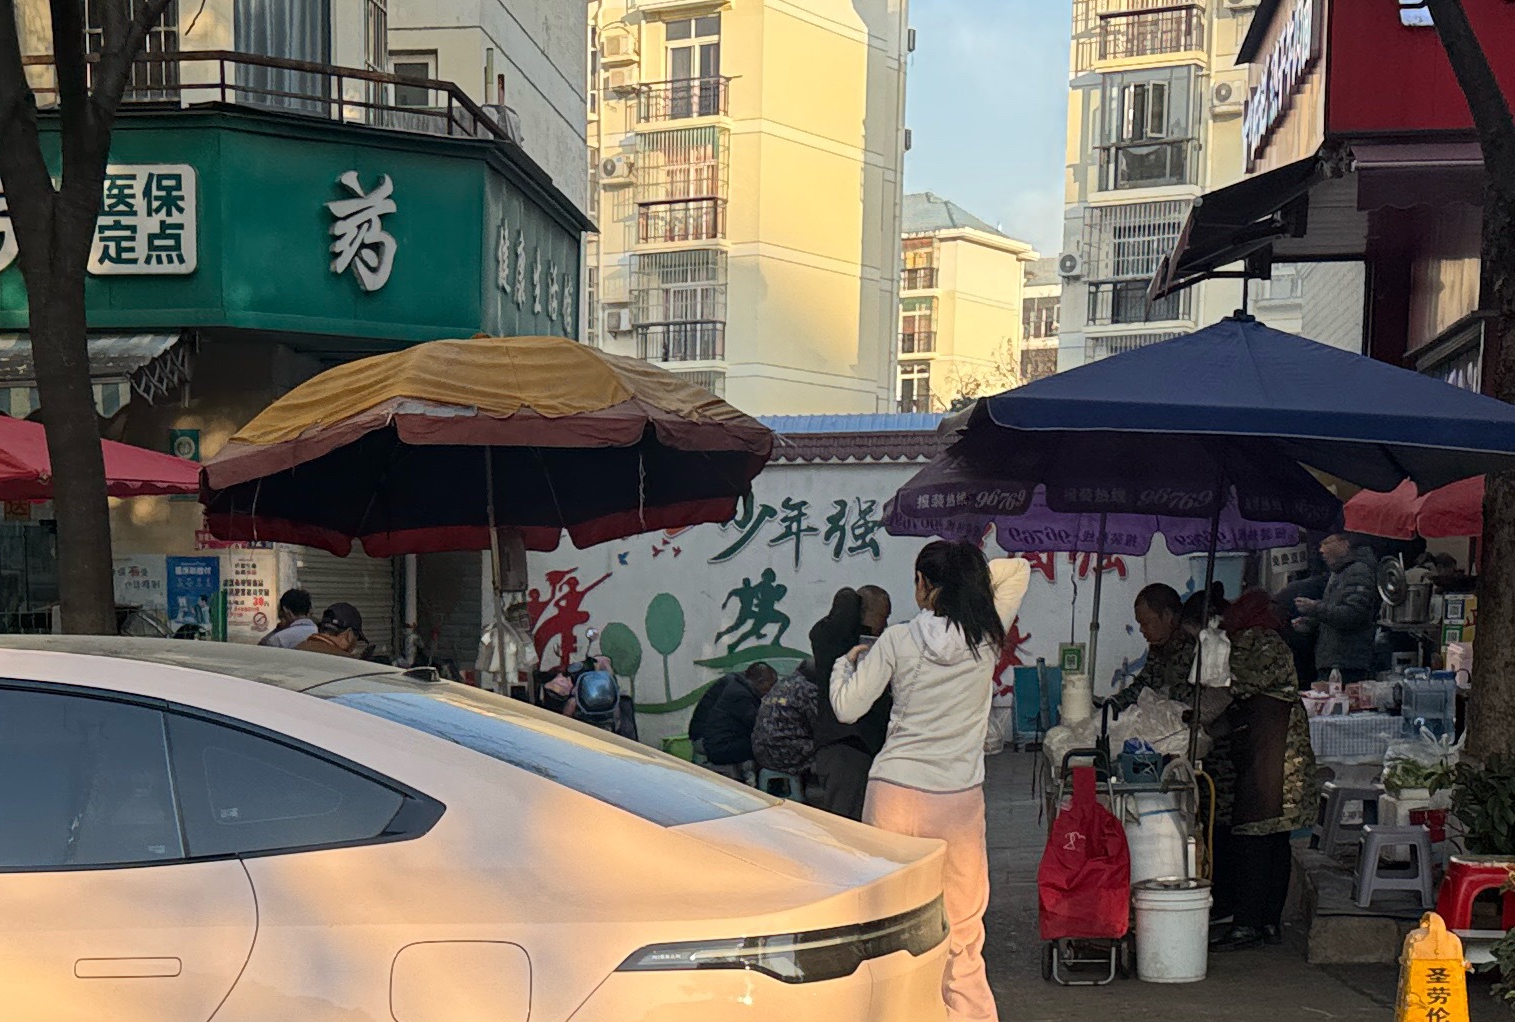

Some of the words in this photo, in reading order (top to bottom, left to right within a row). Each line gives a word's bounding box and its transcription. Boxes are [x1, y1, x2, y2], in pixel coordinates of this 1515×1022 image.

[100, 173, 185, 217] 医保
[97, 219, 186, 266] 定点
[323, 170, 398, 292] 药
[707, 493, 883, 571] 少年强
